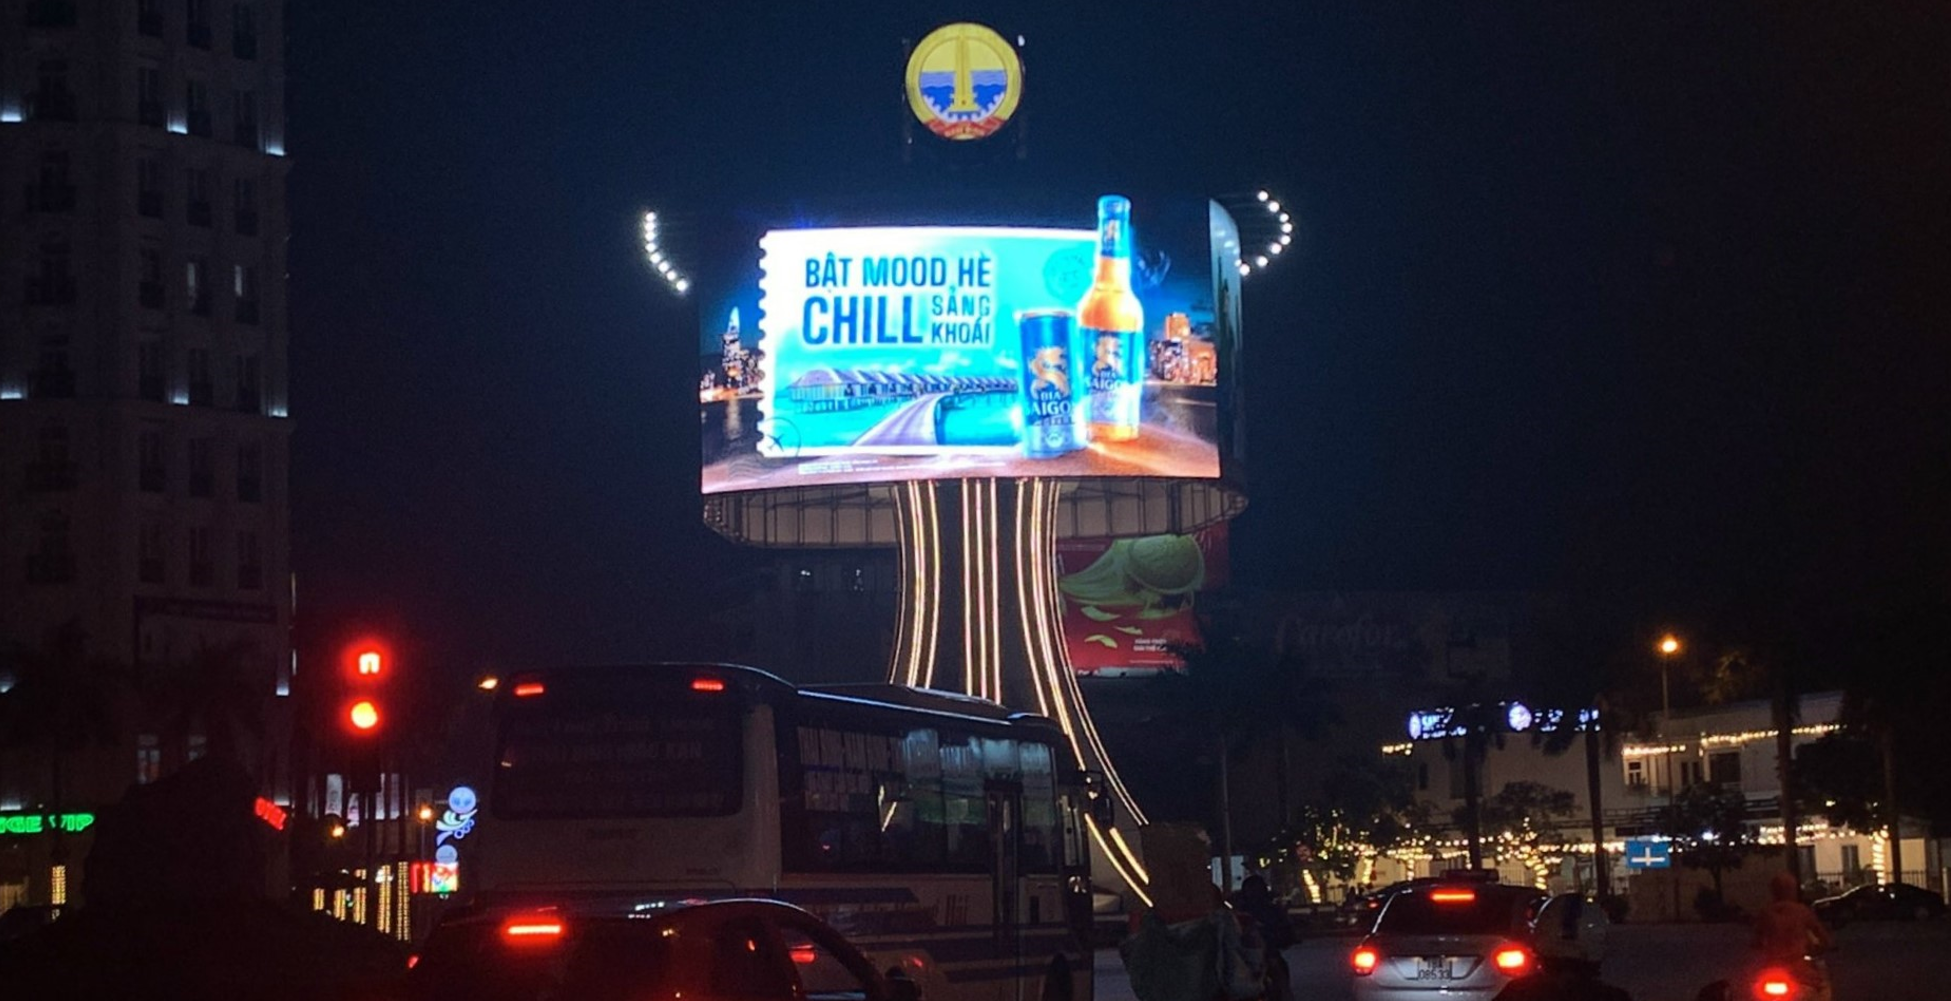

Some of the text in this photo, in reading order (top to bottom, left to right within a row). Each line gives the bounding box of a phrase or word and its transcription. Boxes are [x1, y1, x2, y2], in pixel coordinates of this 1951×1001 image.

[805, 251, 992, 293] BẬT MOOD HÈ
[931, 285, 991, 316] SẢNG
[803, 295, 924, 345] CHILL
[931, 316, 991, 344] KHOÁI
